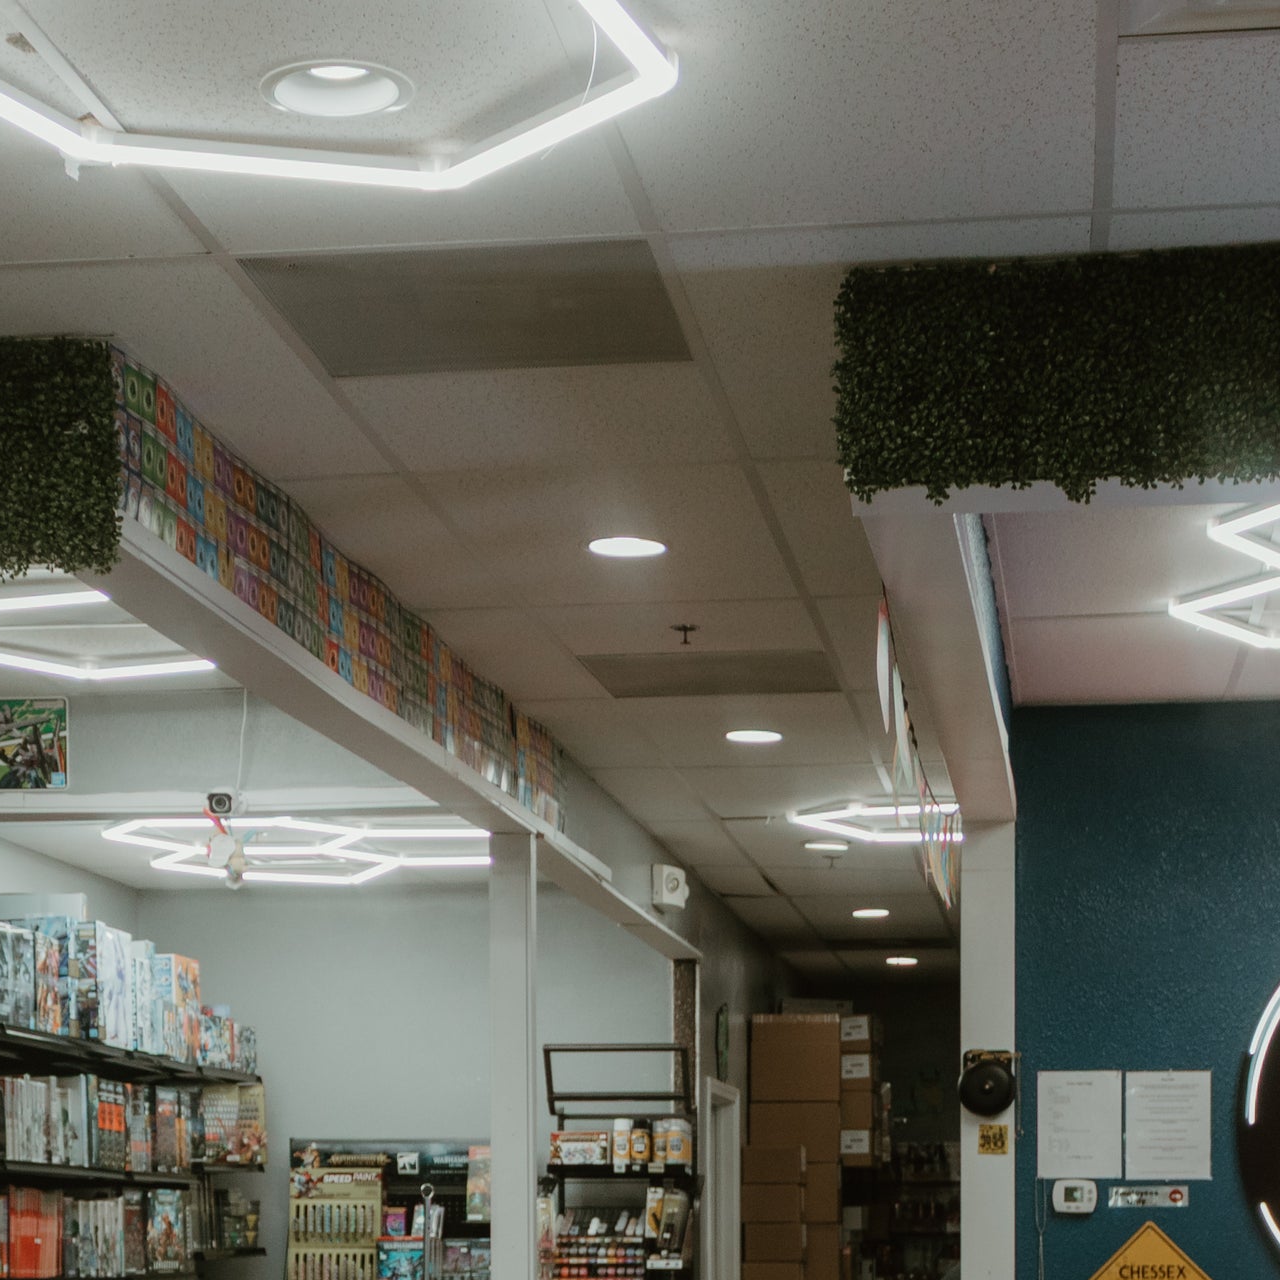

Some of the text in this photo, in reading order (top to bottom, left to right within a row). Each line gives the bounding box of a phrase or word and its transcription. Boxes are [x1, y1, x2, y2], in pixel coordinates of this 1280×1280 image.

[432, 1155, 468, 1166] WARHAMM
[322, 1171, 378, 1184] SPEED PAINT
[1120, 1265, 1187, 1280] CHESSEX
